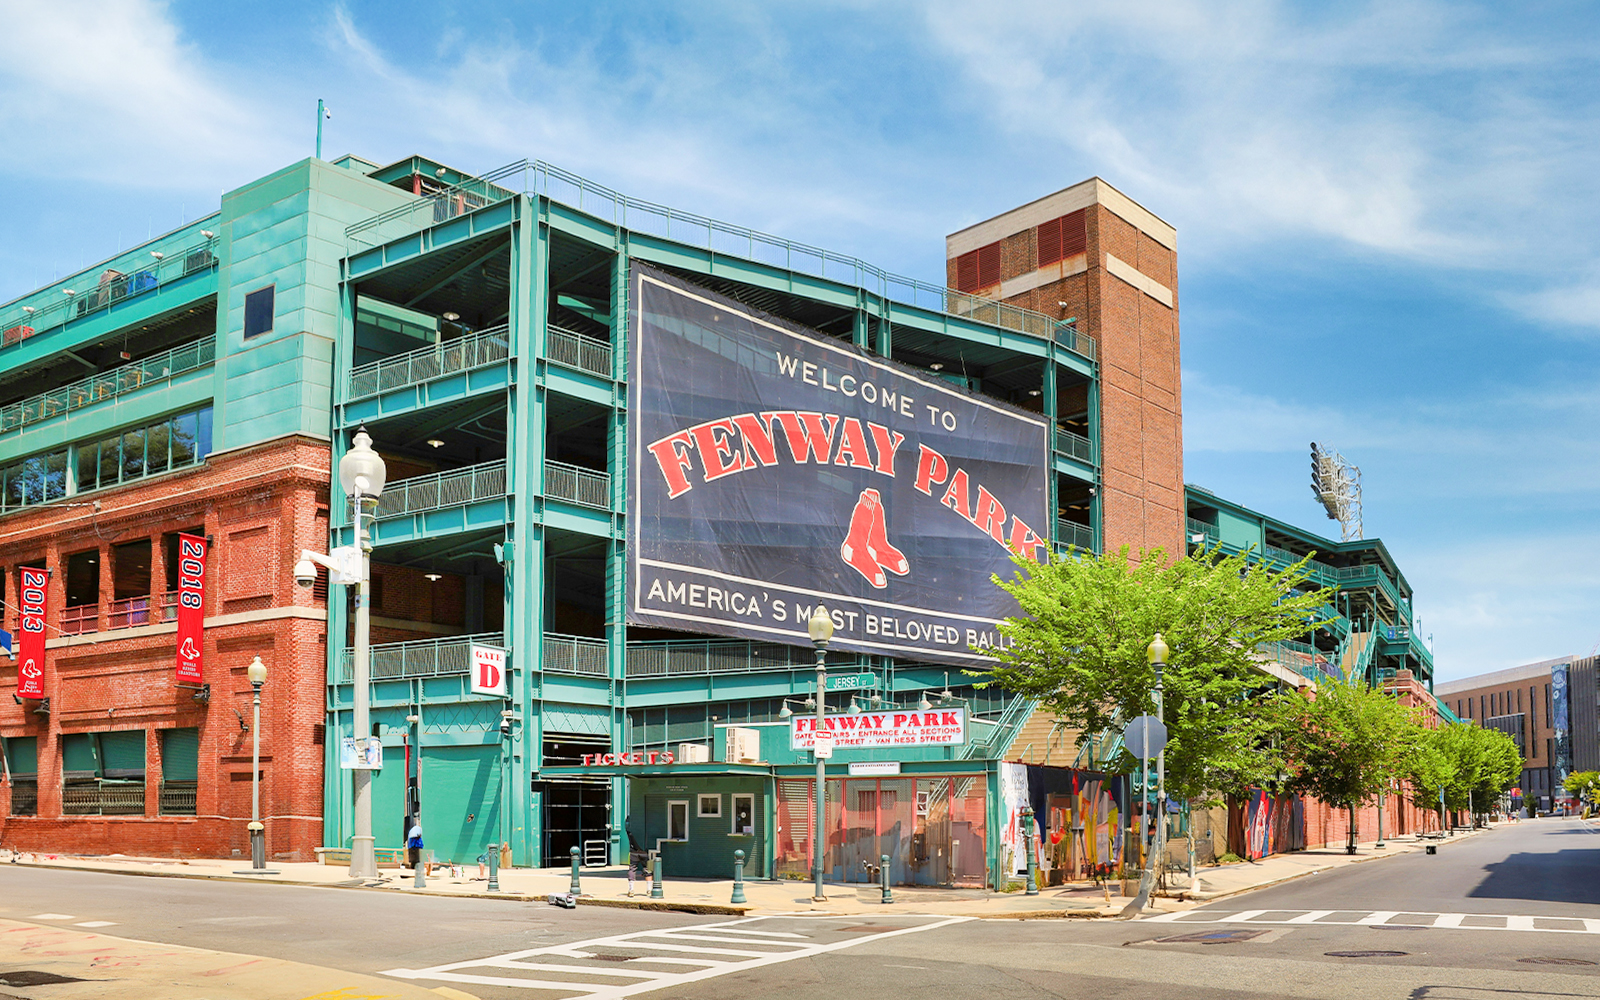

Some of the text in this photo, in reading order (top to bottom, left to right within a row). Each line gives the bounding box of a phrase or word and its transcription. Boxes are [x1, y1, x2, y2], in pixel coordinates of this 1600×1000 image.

[776, 351, 957, 432] WELCOME TO
[647, 410, 1046, 565] FENWAY PARK
[180, 540, 204, 609] 2018
[23, 571, 45, 633] 2013
[647, 578, 787, 622] AMERICA'S
[796, 603, 859, 632] MST
[865, 615, 959, 645] BELOVED
[475, 650, 503, 662] GATE
[478, 662, 500, 689] D
[833, 676, 860, 689] JERSEY
[893, 712, 959, 728] PARK
[835, 738, 865, 746] STREET
[894, 736, 916, 744] NESS
[920, 734, 952, 743] STREET
[858, 729, 899, 737] ENTRANCE
[920, 726, 961, 735] SECTIONS
[580, 750, 675, 767] TICKETS
